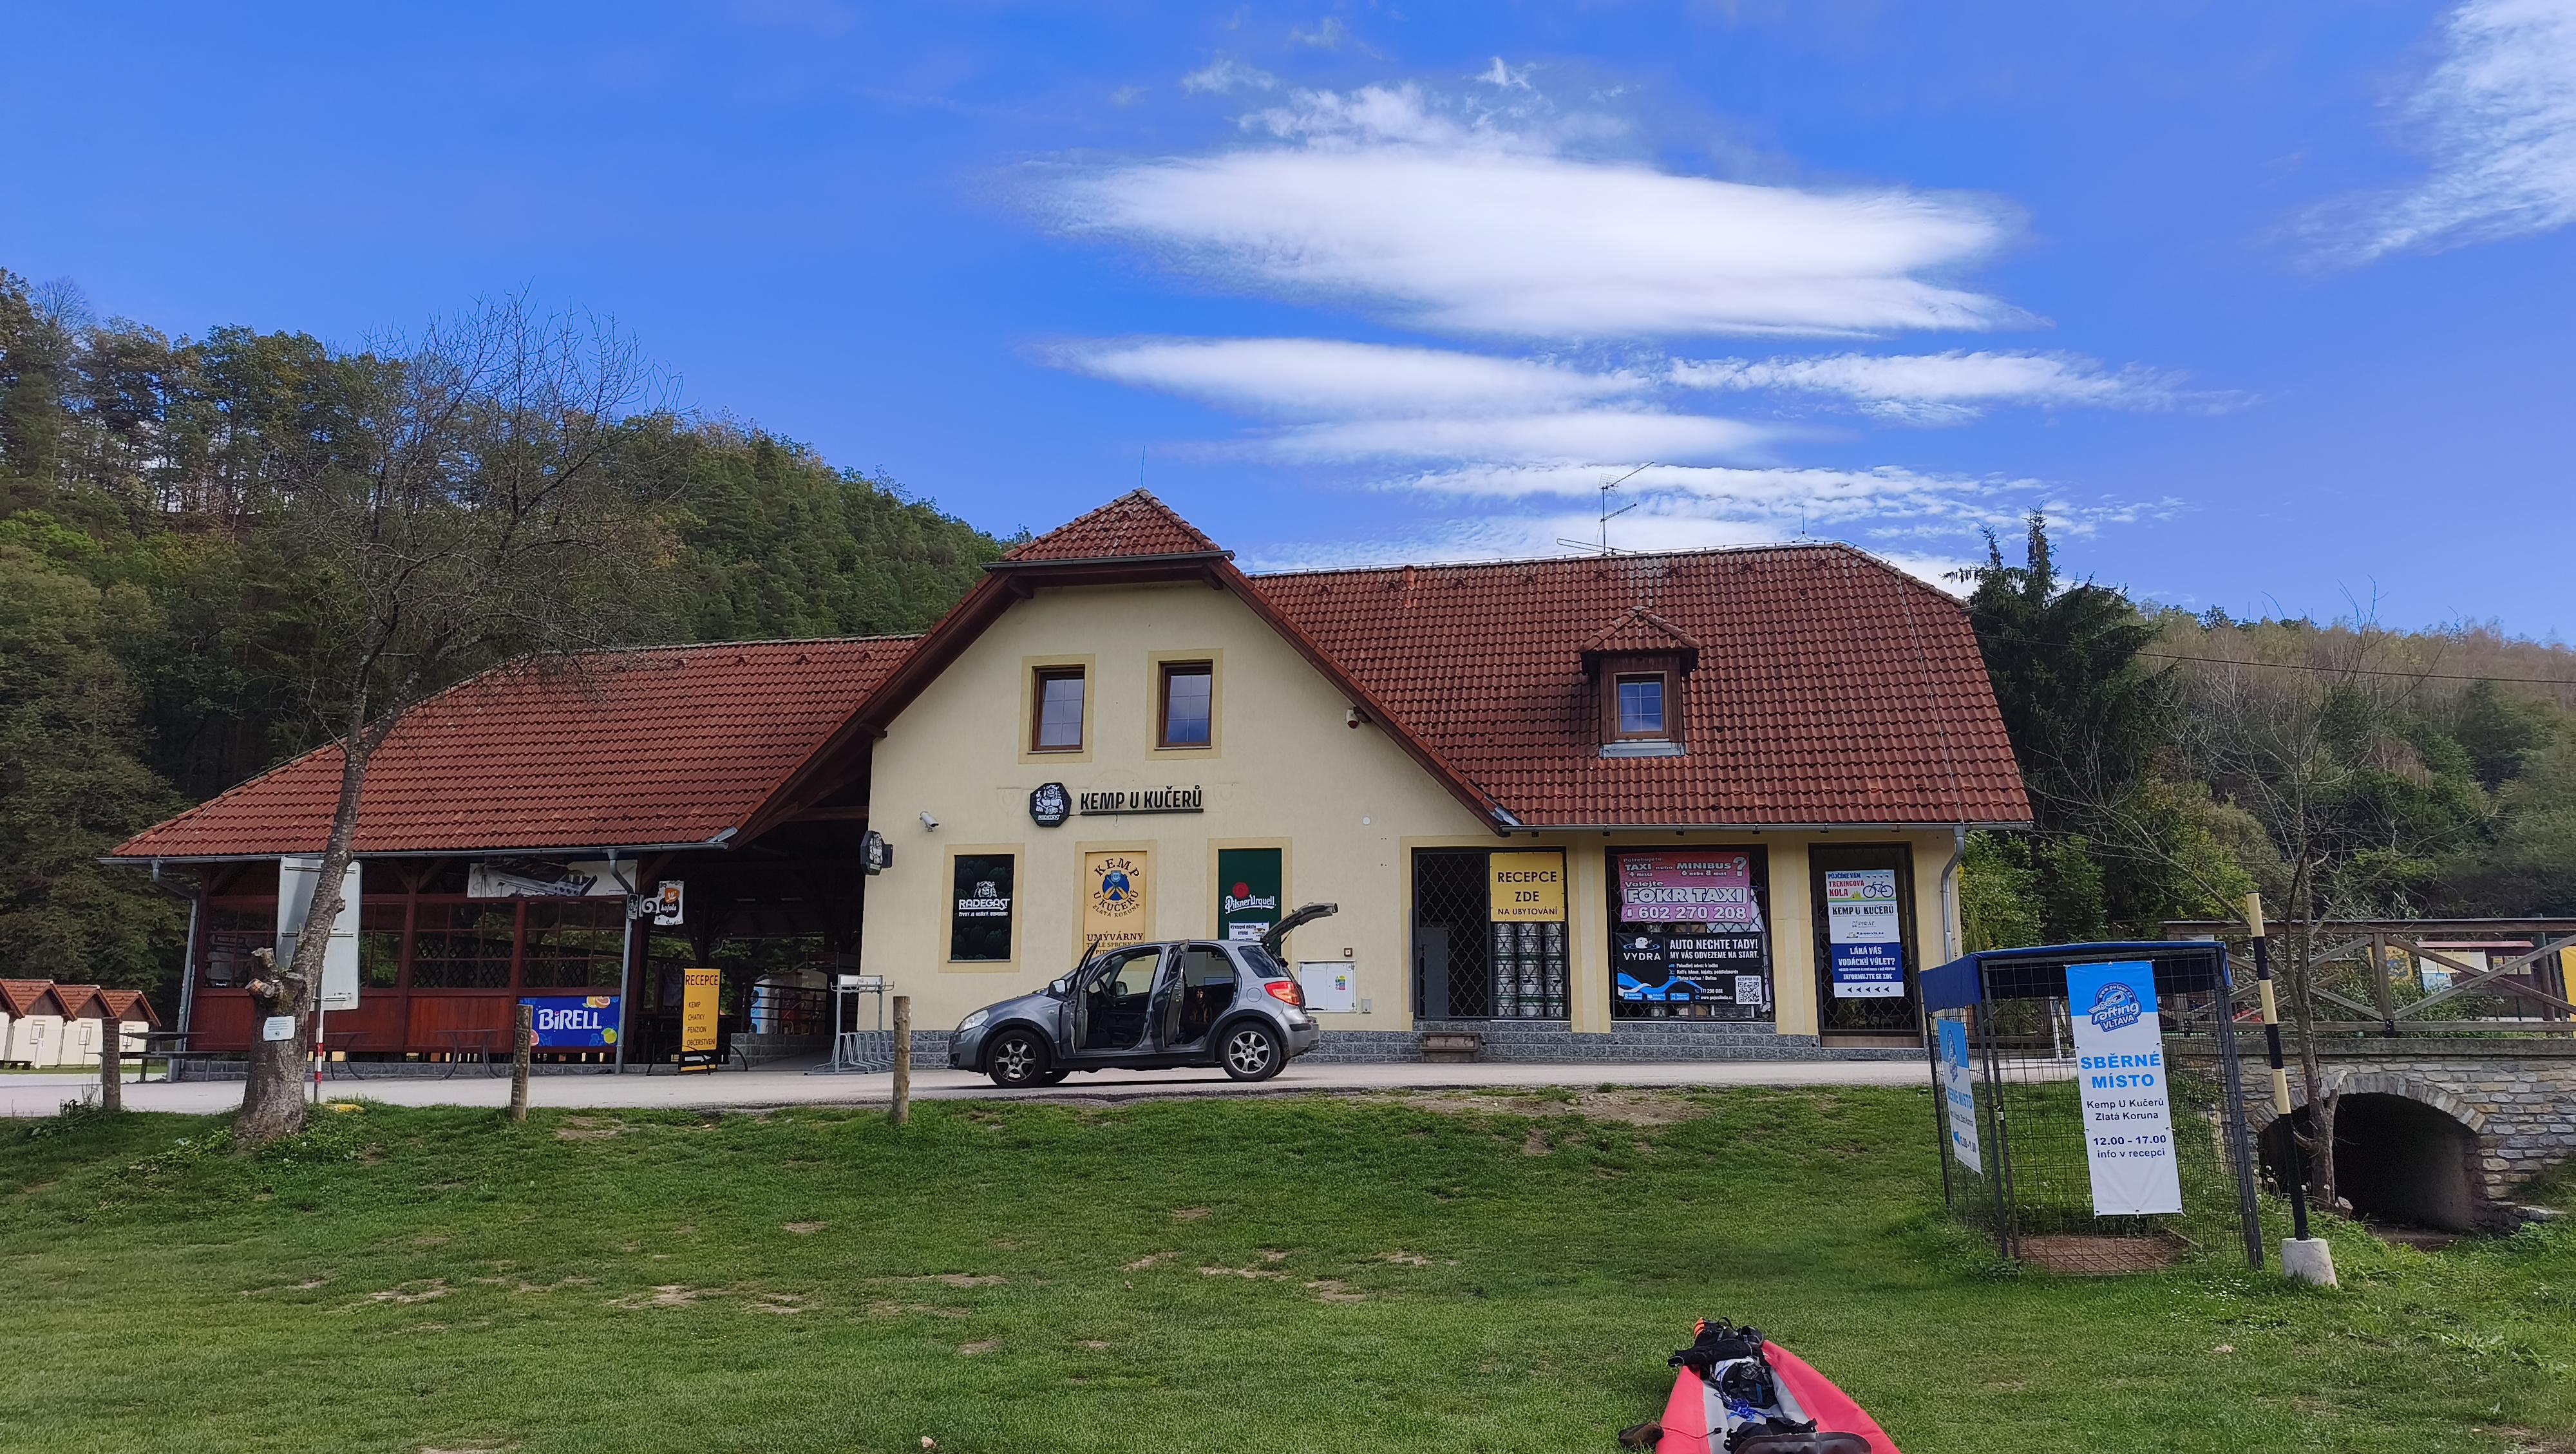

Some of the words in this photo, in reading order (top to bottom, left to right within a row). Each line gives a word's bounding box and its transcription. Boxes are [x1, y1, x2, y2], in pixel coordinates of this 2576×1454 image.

[1080, 792, 1125, 810] KEMP
[1129, 791, 1139, 809] U
[1143, 784, 1202, 808] KUČERŮ
[1094, 857, 1140, 877] KEMP
[1497, 871, 1557, 883] RECEPCE
[1515, 891, 1540, 902] ZDE
[1627, 888, 1687, 903] FOKR
[1692, 888, 1745, 903] TAXI
[1829, 889, 1848, 897] KOLA
[958, 898, 1010, 911] RADEGAST
[1098, 890, 1139, 912] KUČERŮ
[1224, 895, 1250, 914] Pilsner
[1249, 894, 1274, 910] Urquell
[661, 903, 677, 913] kofola
[1092, 903, 1112, 918] ZLATÁ
[1114, 903, 1141, 918] KORUNA
[1512, 906, 1558, 915] UBYTOVÁNÍ
[1638, 906, 1671, 920] 602
[1676, 906, 1708, 920] 270
[1714, 907, 1747, 920] 208
[1832, 906, 1853, 915] KEMP
[1855, 906, 1861, 915] U
[1863, 904, 1894, 914] KUČERŮ
[1086, 930, 1144, 941] UMÝVÁRNY
[1669, 939, 1693, 950] AUTO
[1696, 939, 1730, 950] NECHTE
[1732, 938, 1758, 949] TADY!
[1850, 946, 1868, 955] LÁKÁ
[1868, 945, 1882, 955] VÁS
[1624, 952, 1662, 961] VYDRA
[1670, 951, 1679, 959] MY
[1681, 950, 1693, 959] VÁS
[1738, 950, 1759, 959] START.
[1838, 956, 1869, 966] VODÁCKÝ
[1870, 956, 1895, 965] VÝLET?
[685, 974, 719, 986] RECEPCE
[2094, 1003, 2139, 1023] rafting
[2103, 1014, 2135, 1029] VLTAVA
[687, 1038, 716, 1046] OBČERSTVENÍ
[2080, 1051, 2161, 1070] SBĚRNÉ
[2091, 1073, 2154, 1089] MÍSTO
[2087, 1100, 2116, 1110] Kemp
[2129, 1098, 2164, 1108] Kučerů
[2095, 1113, 2120, 1121] Zlatá
[2093, 1137, 2125, 1146] 12.00
[2136, 1135, 2166, 1144] 17.00
[2128, 1147, 2165, 1158] recepci
